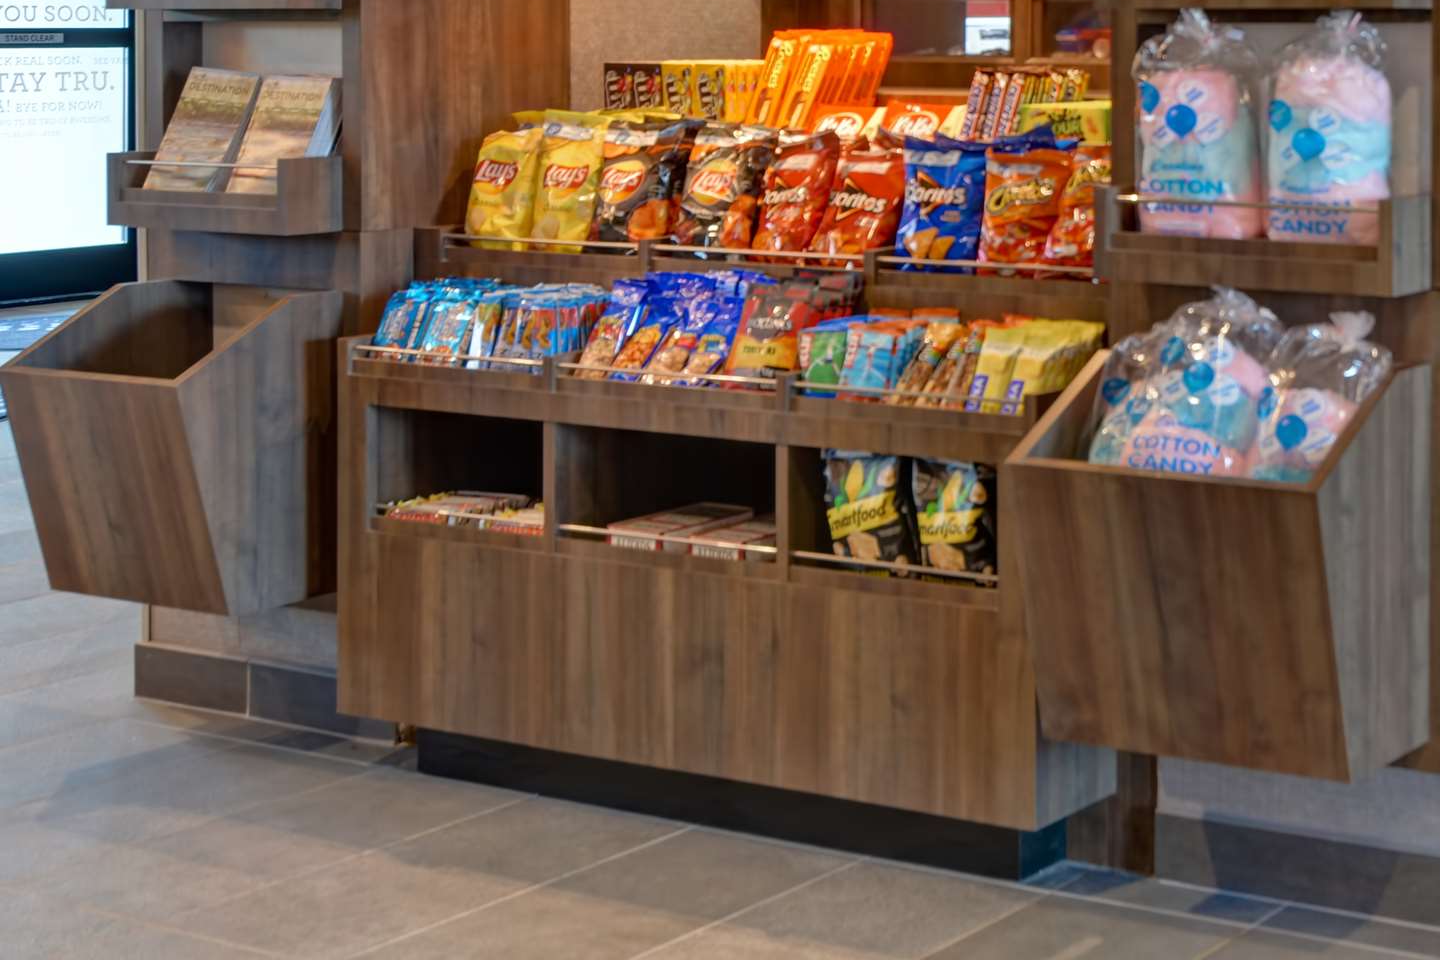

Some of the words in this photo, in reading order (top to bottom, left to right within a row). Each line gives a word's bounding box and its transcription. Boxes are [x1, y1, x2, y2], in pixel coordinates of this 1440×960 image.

[55, 71, 115, 92] TRU.
[475, 160, 518, 184] Lay's
[546, 165, 588, 188] Lay's
